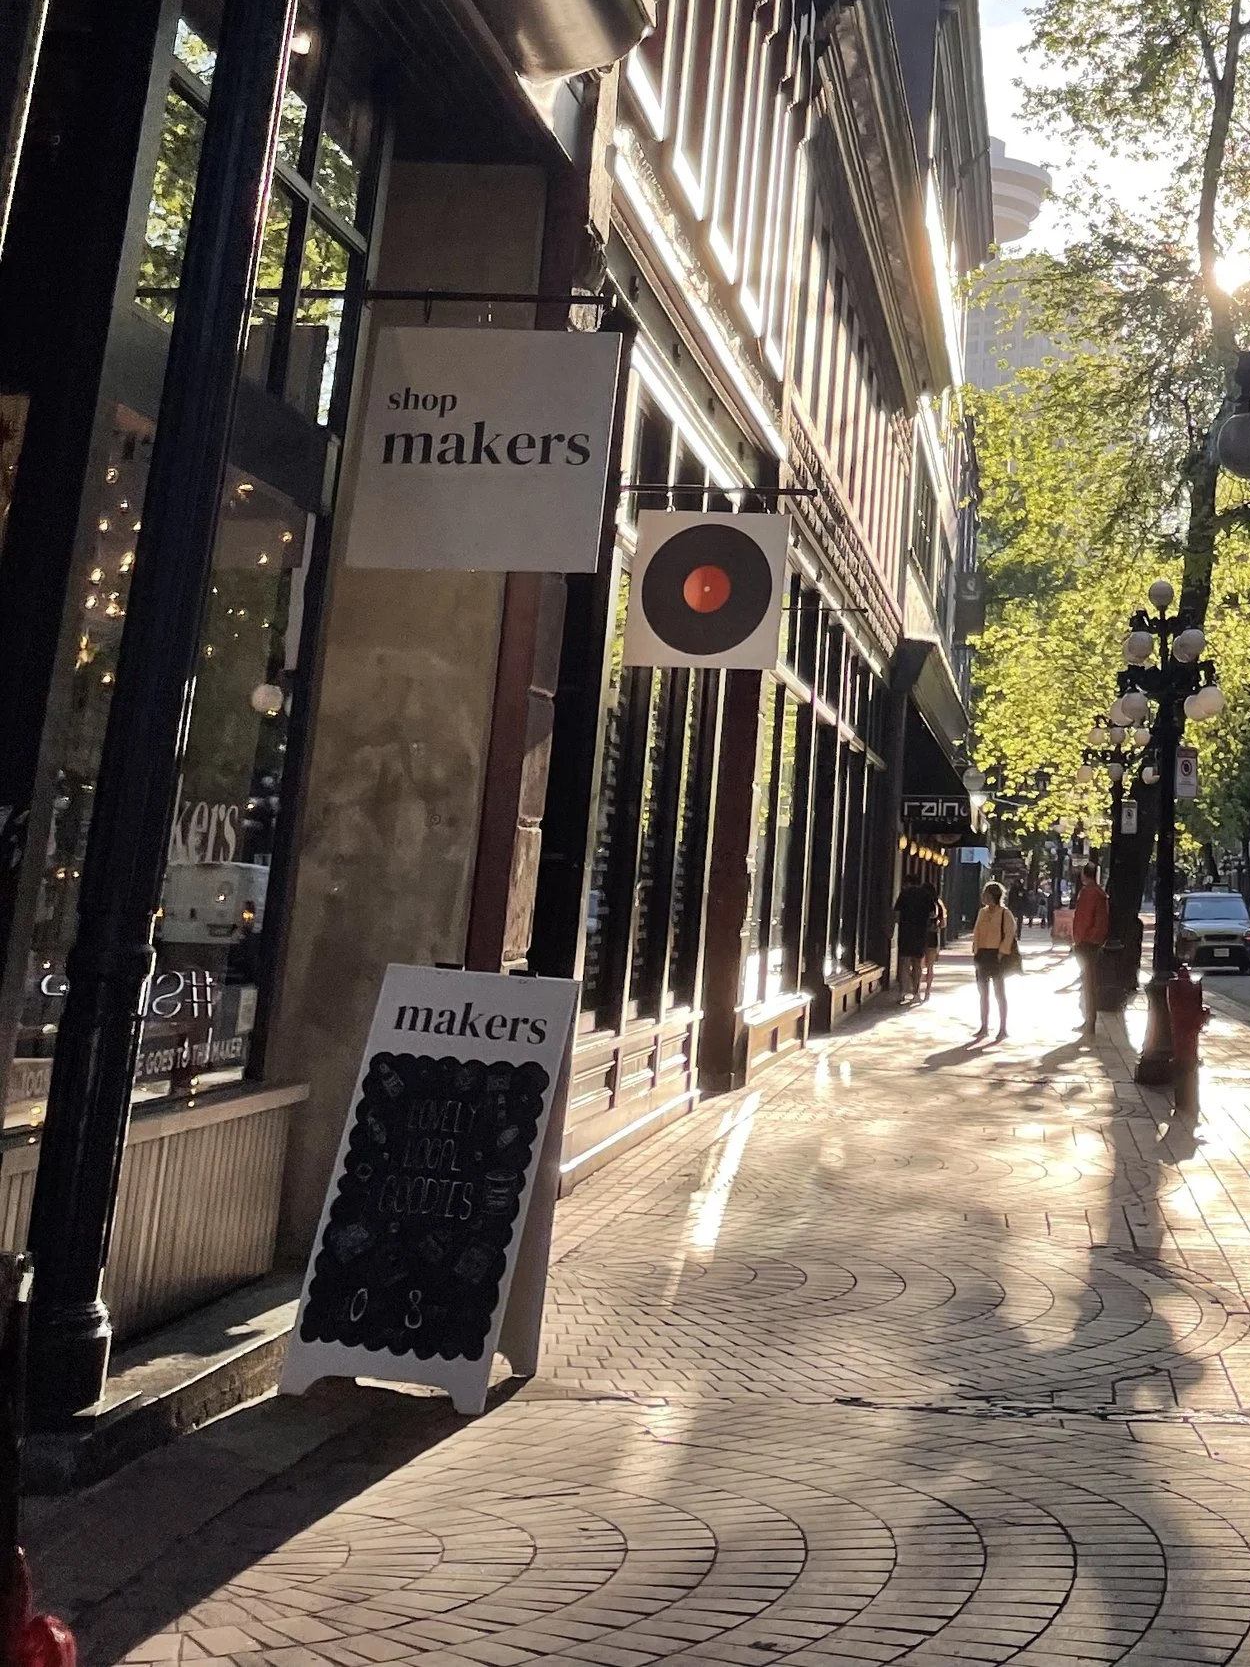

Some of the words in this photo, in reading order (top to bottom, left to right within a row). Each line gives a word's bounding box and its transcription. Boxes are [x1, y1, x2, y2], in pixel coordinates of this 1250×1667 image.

[387, 387, 458, 419] shop
[381, 420, 592, 467] makers
[903, 797, 959, 817] rain
[393, 1001, 549, 1045] makers
[407, 1098, 482, 1133] LOVELY
[402, 1136, 462, 1172] LOCAL
[378, 1173, 474, 1221] GOODIES
